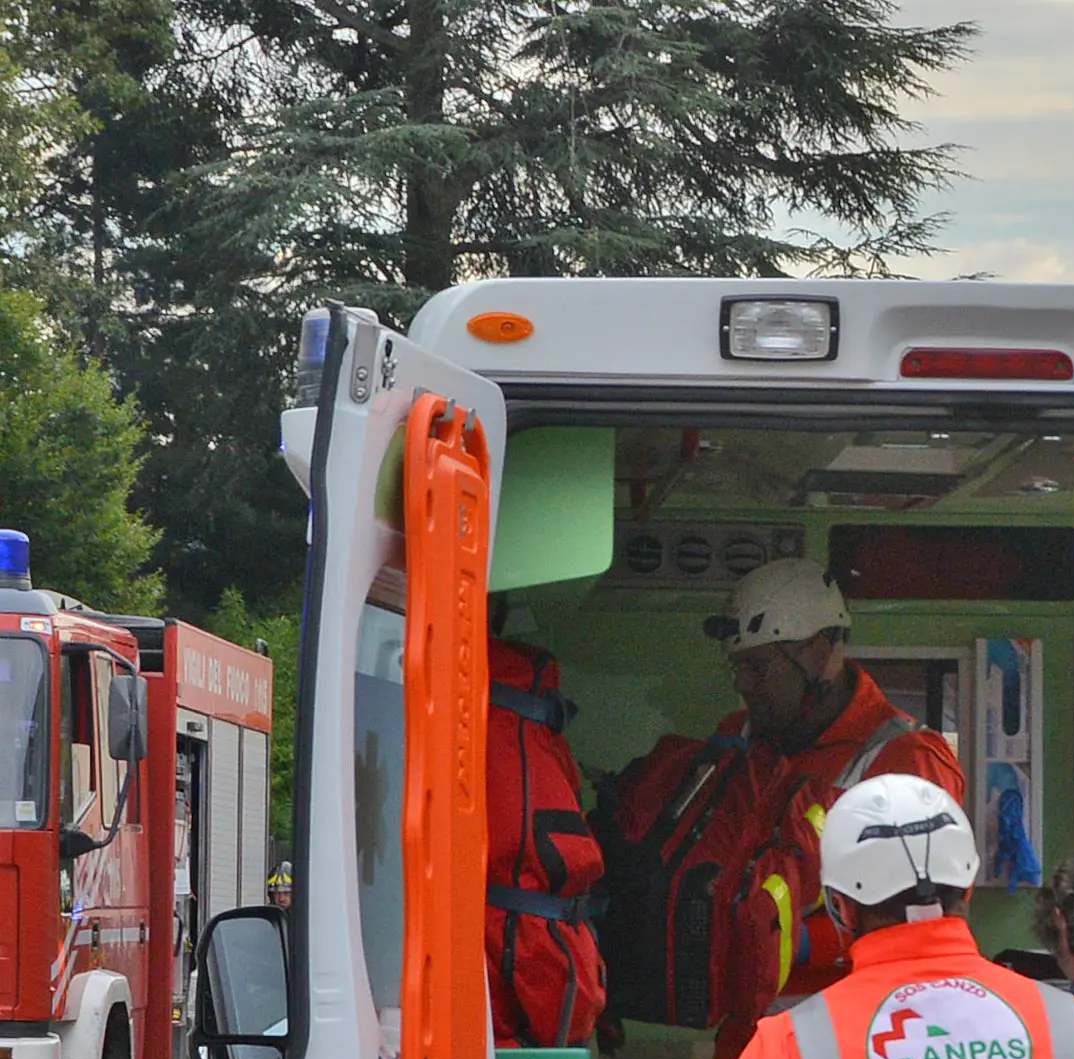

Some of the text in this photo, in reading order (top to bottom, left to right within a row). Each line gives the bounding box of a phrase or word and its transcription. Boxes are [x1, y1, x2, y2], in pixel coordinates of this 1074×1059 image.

[208, 656, 222, 695] DEL
[226, 665, 250, 706] FUOCO
[894, 979, 987, 1003] SOS CANZO
